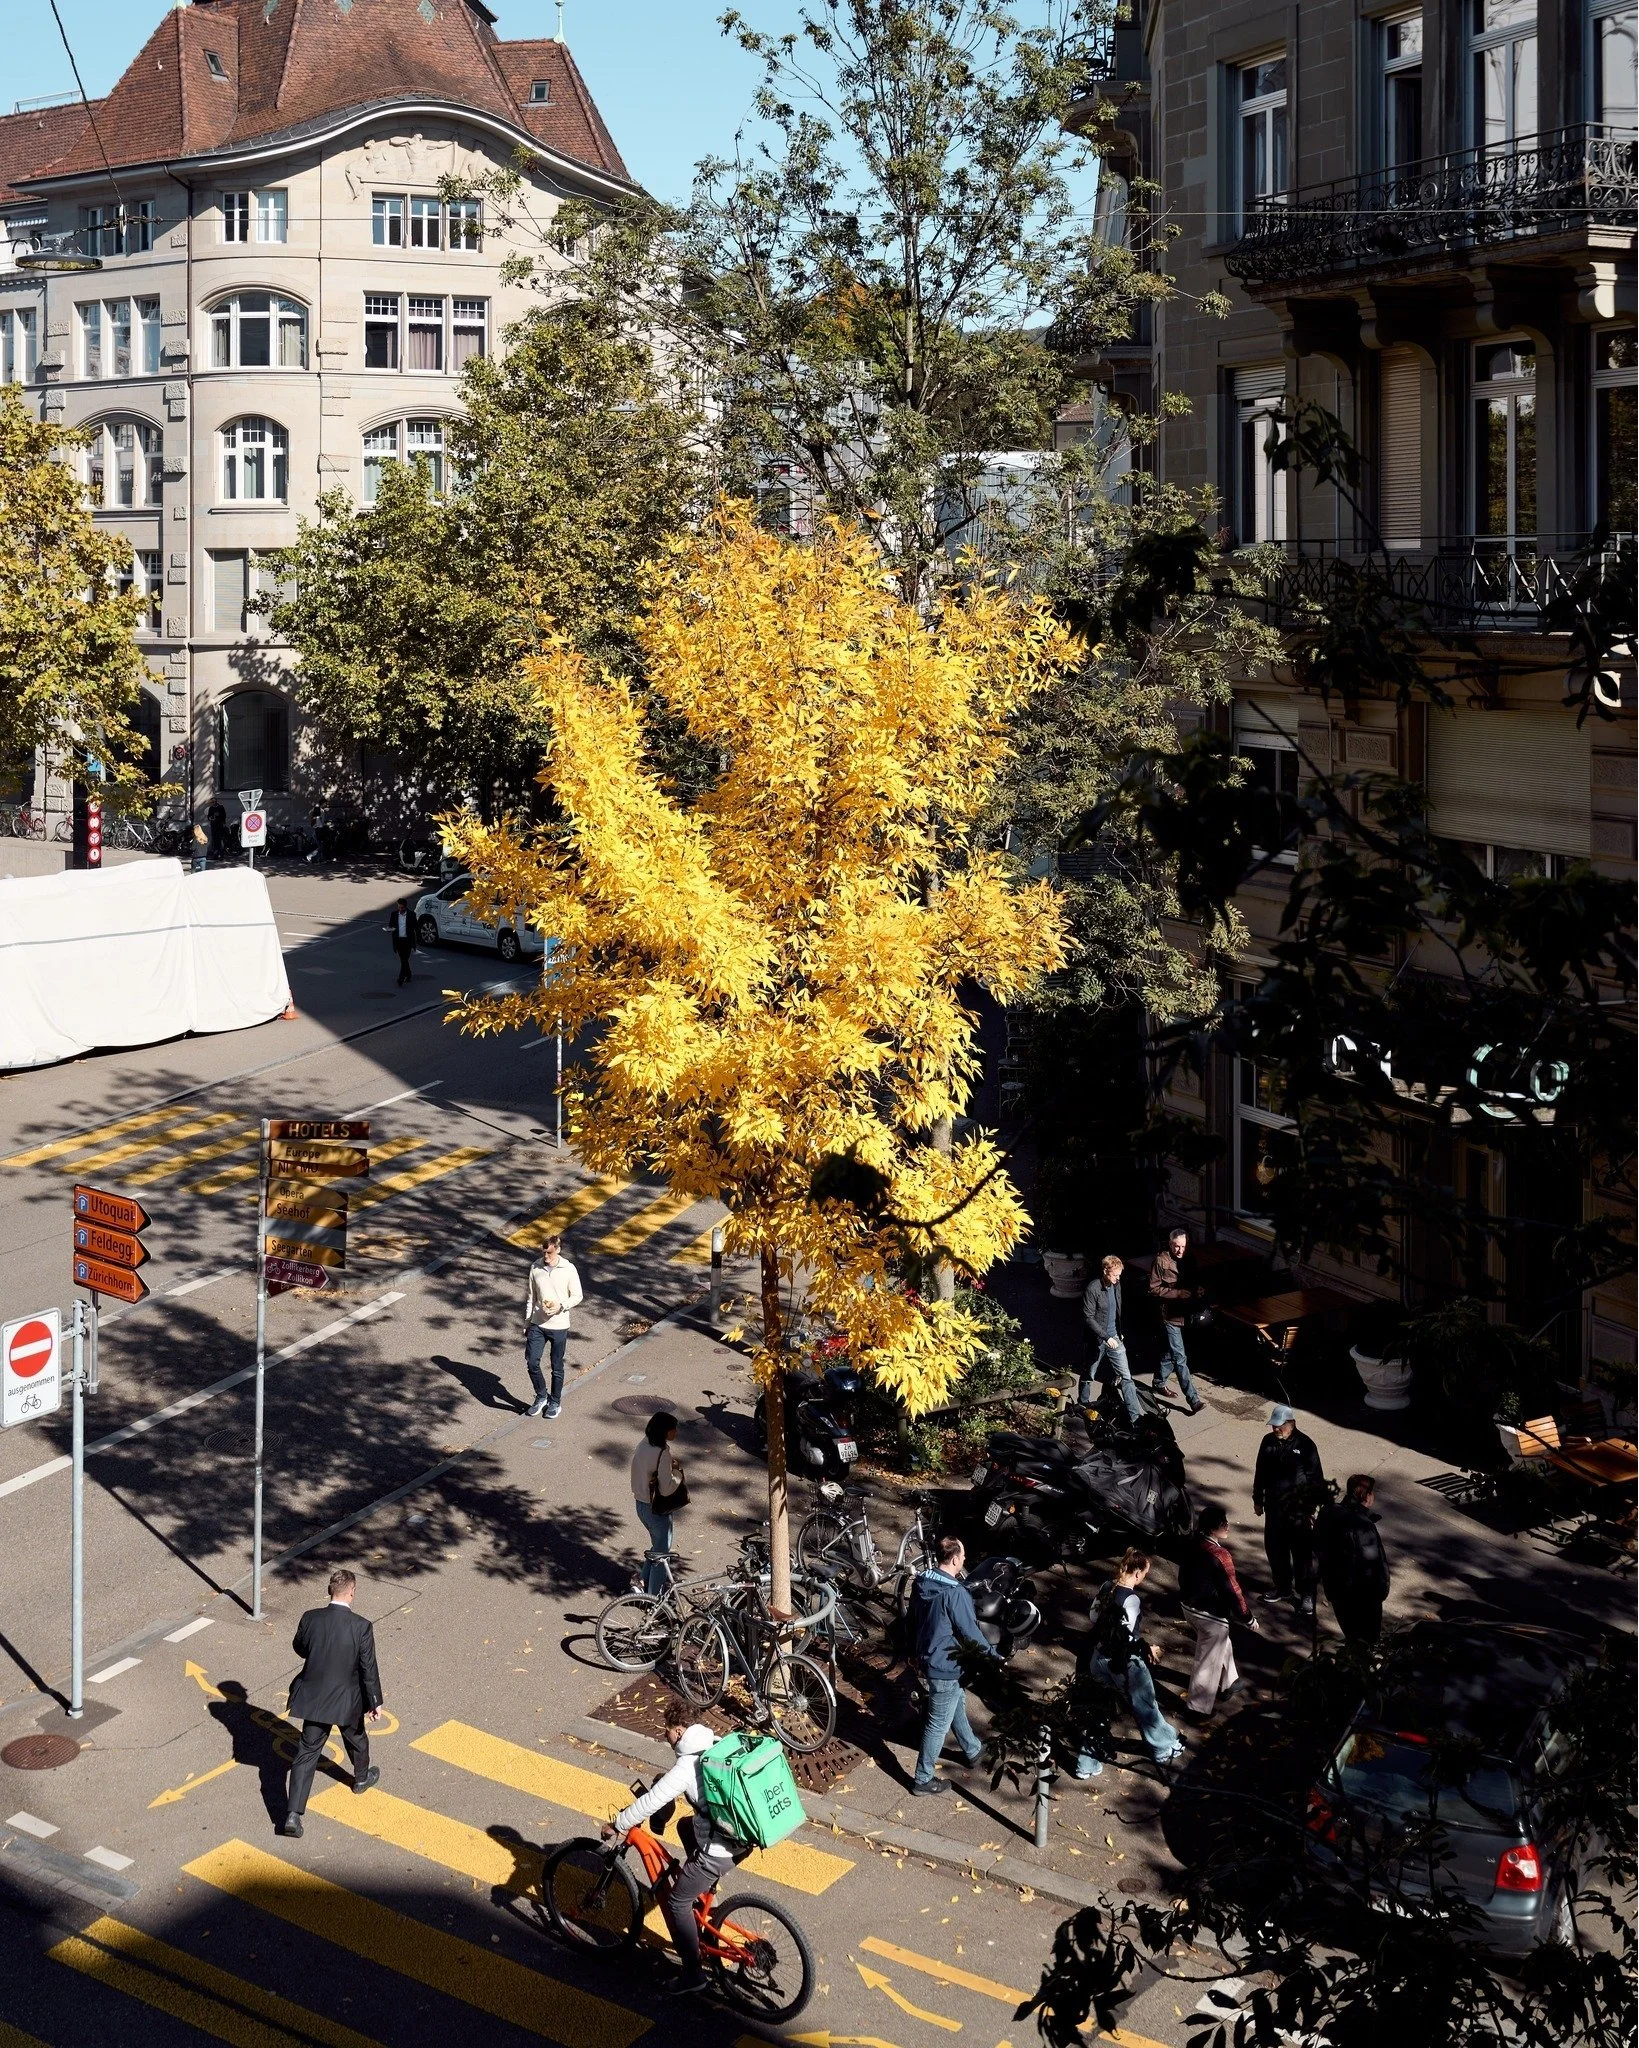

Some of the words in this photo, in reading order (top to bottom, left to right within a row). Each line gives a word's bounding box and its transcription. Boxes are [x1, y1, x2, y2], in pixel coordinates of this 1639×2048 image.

[288, 1123, 350, 1138] HOTELS
[285, 1147, 321, 1160] Europe
[279, 1186, 305, 1200] Opera
[80, 1200, 86, 1210] P
[91, 1196, 135, 1222] Utoquai
[276, 1203, 311, 1219] Seehof
[80, 1234, 86, 1244] P
[91, 1231, 134, 1260] Feldegg
[271, 1240, 313, 1258] Seegarten
[281, 1262, 320, 1278] Zollikerberg
[287, 1272, 314, 1285] Zollikon
[80, 1267, 86, 1277] P
[88, 1267, 133, 1293] Zürichhorn
[7, 1375, 55, 1397] ausgenommen
[768, 1797, 792, 1819] Eats
